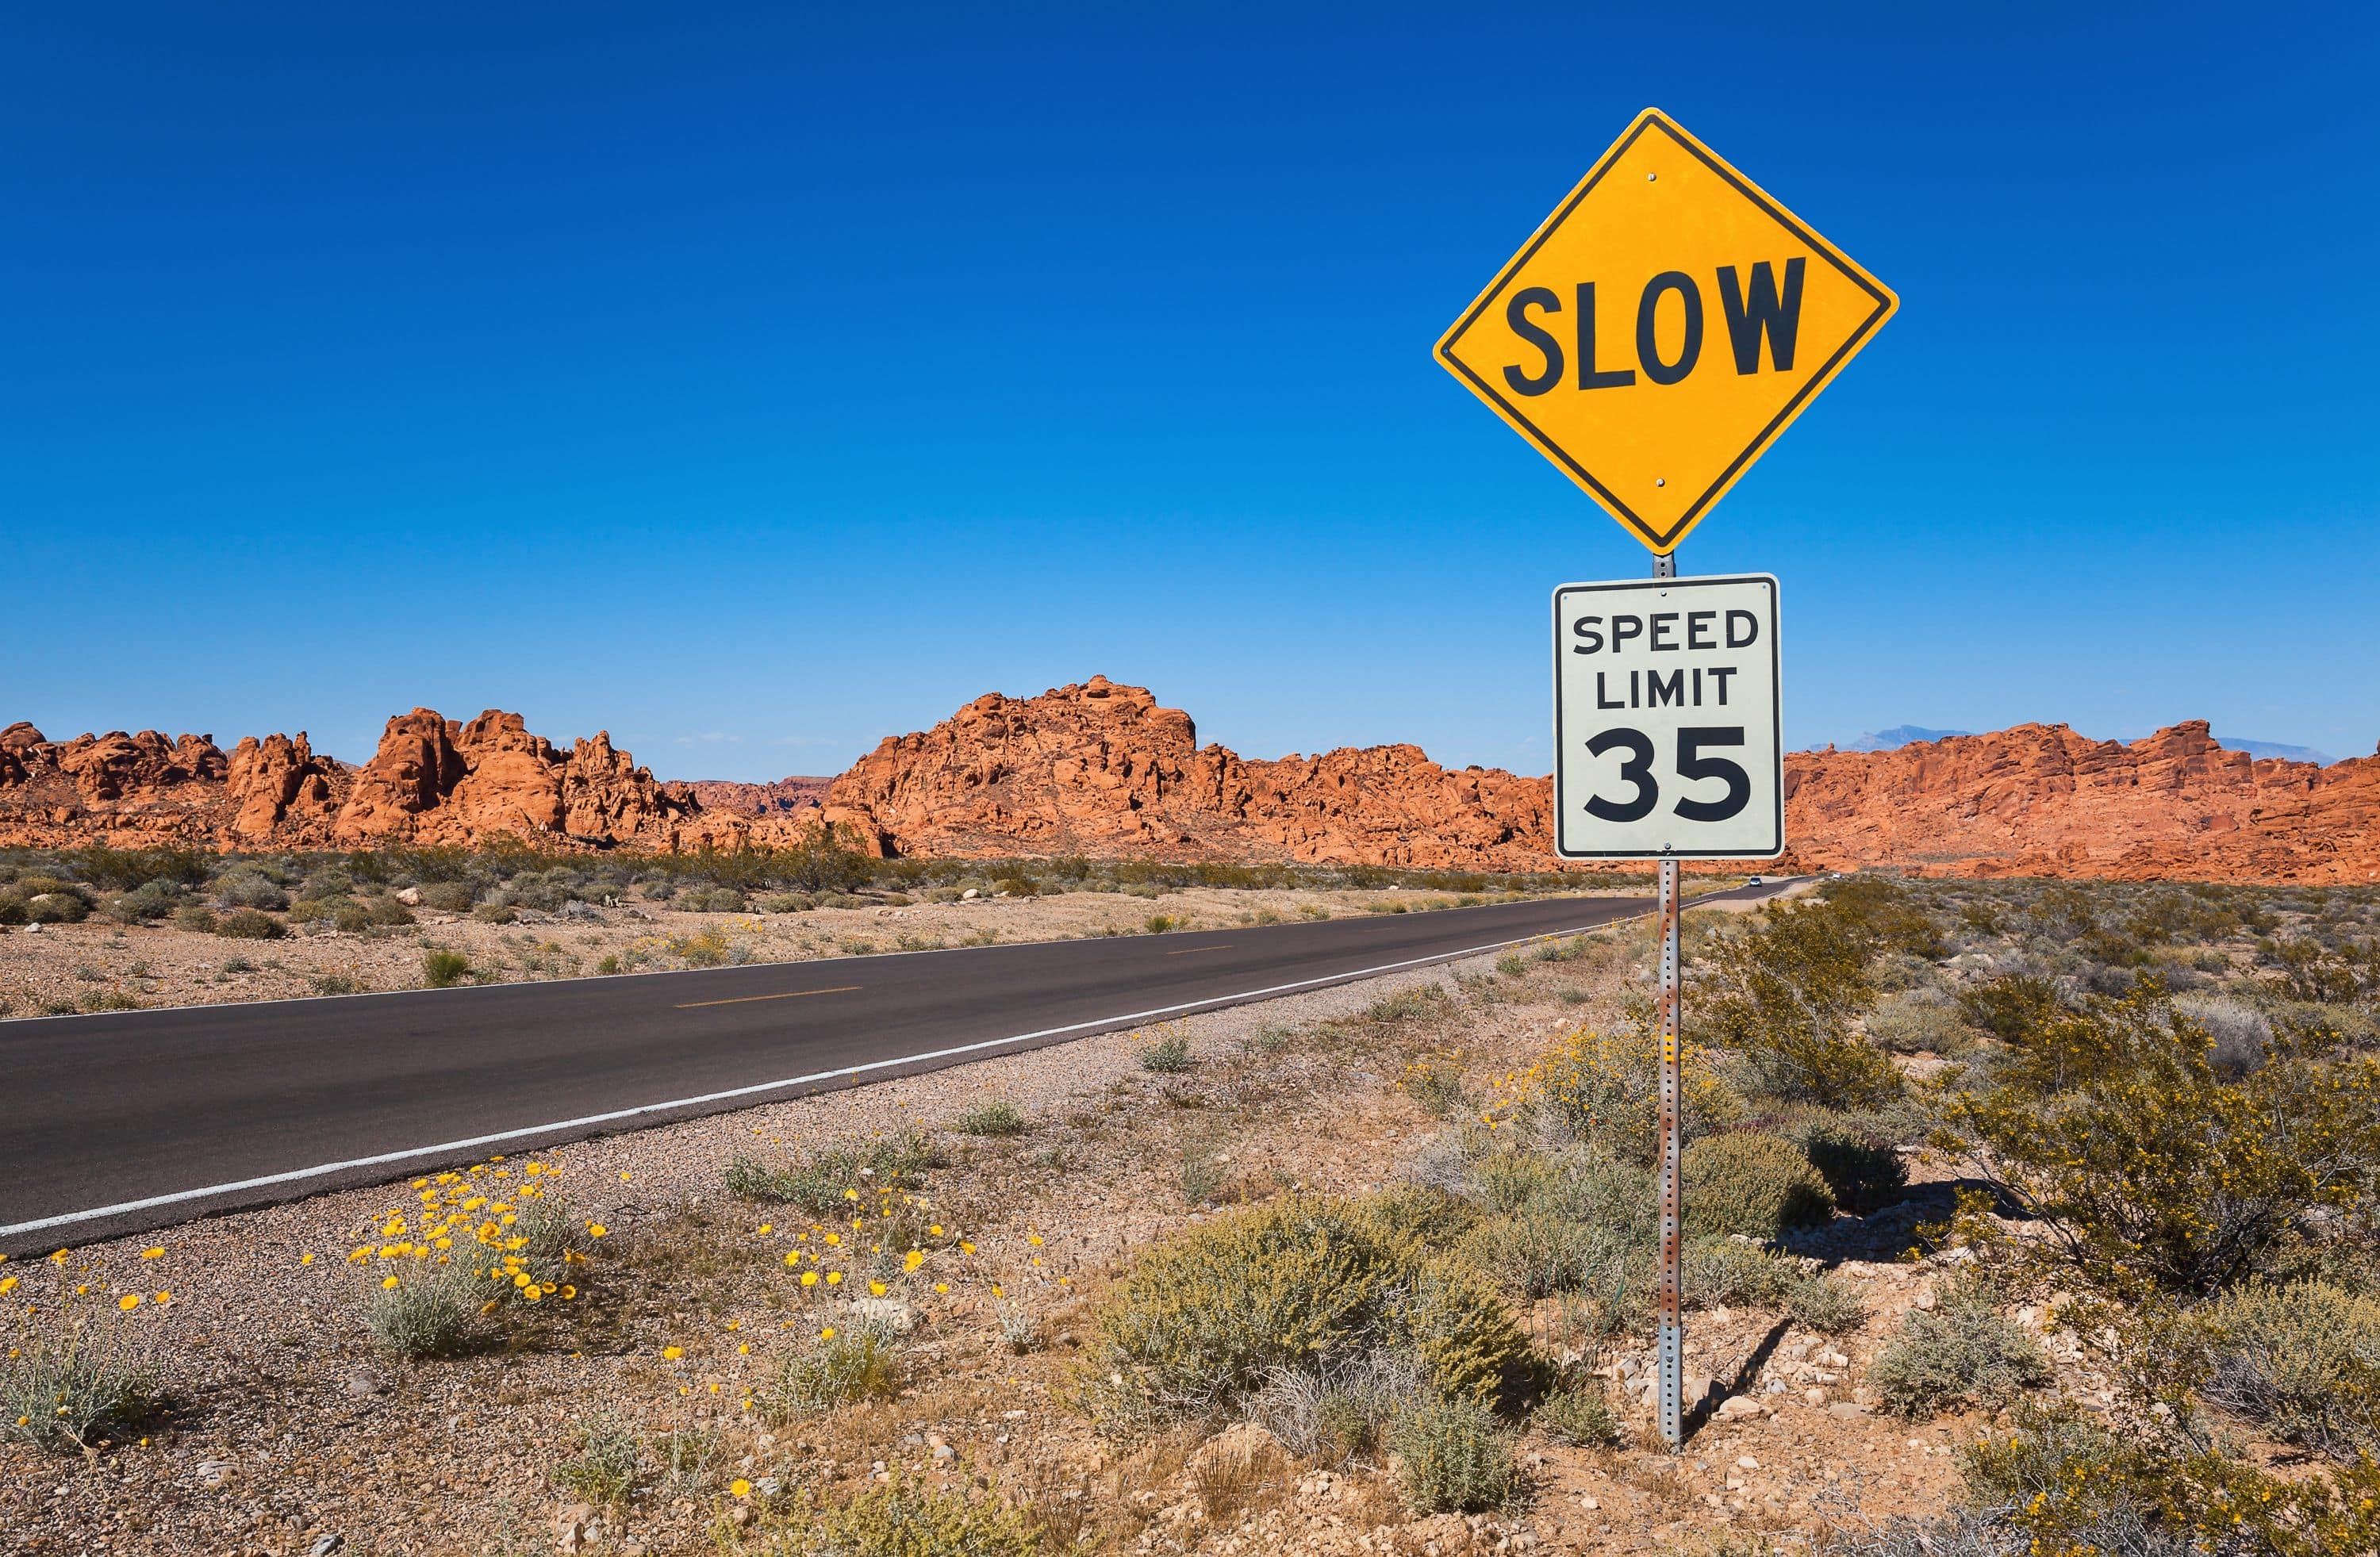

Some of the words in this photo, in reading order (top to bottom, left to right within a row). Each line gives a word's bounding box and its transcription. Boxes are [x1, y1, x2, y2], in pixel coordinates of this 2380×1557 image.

[1503, 256, 1806, 397] SLOW
[1573, 609, 1759, 655] SPEED
[1596, 666, 1737, 710] LIMIT
[1583, 726, 1752, 823] 35
